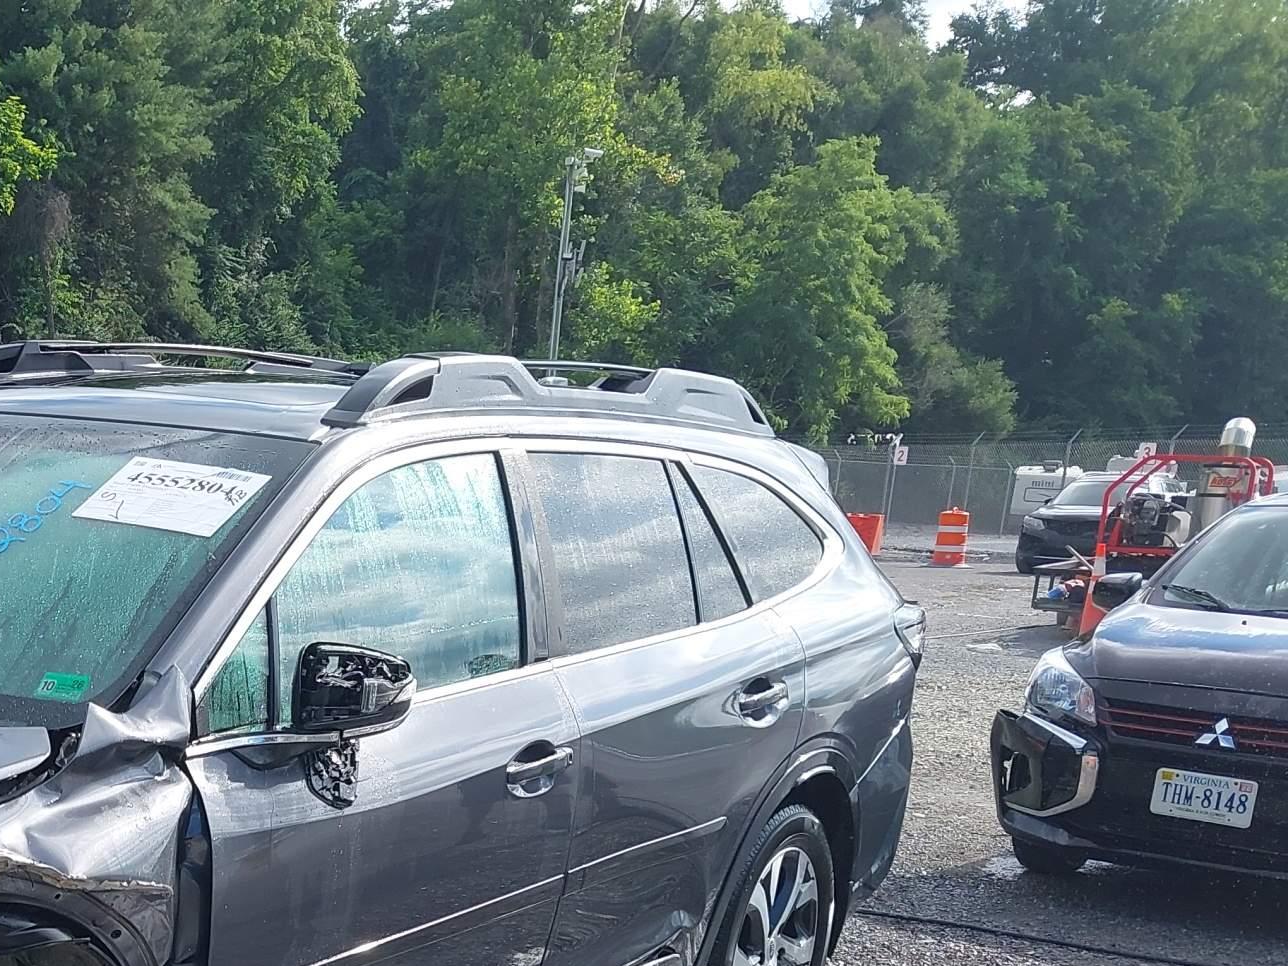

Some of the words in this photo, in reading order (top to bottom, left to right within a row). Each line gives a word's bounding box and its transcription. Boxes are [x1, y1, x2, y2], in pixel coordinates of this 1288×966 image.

[897, 450, 905, 462] 2
[127, 471, 236, 497] 45552804
[42, 680, 56, 691] 10
[1183, 775, 1230, 789] VIRGINIA
[1162, 782, 1249, 814] THM-8148
